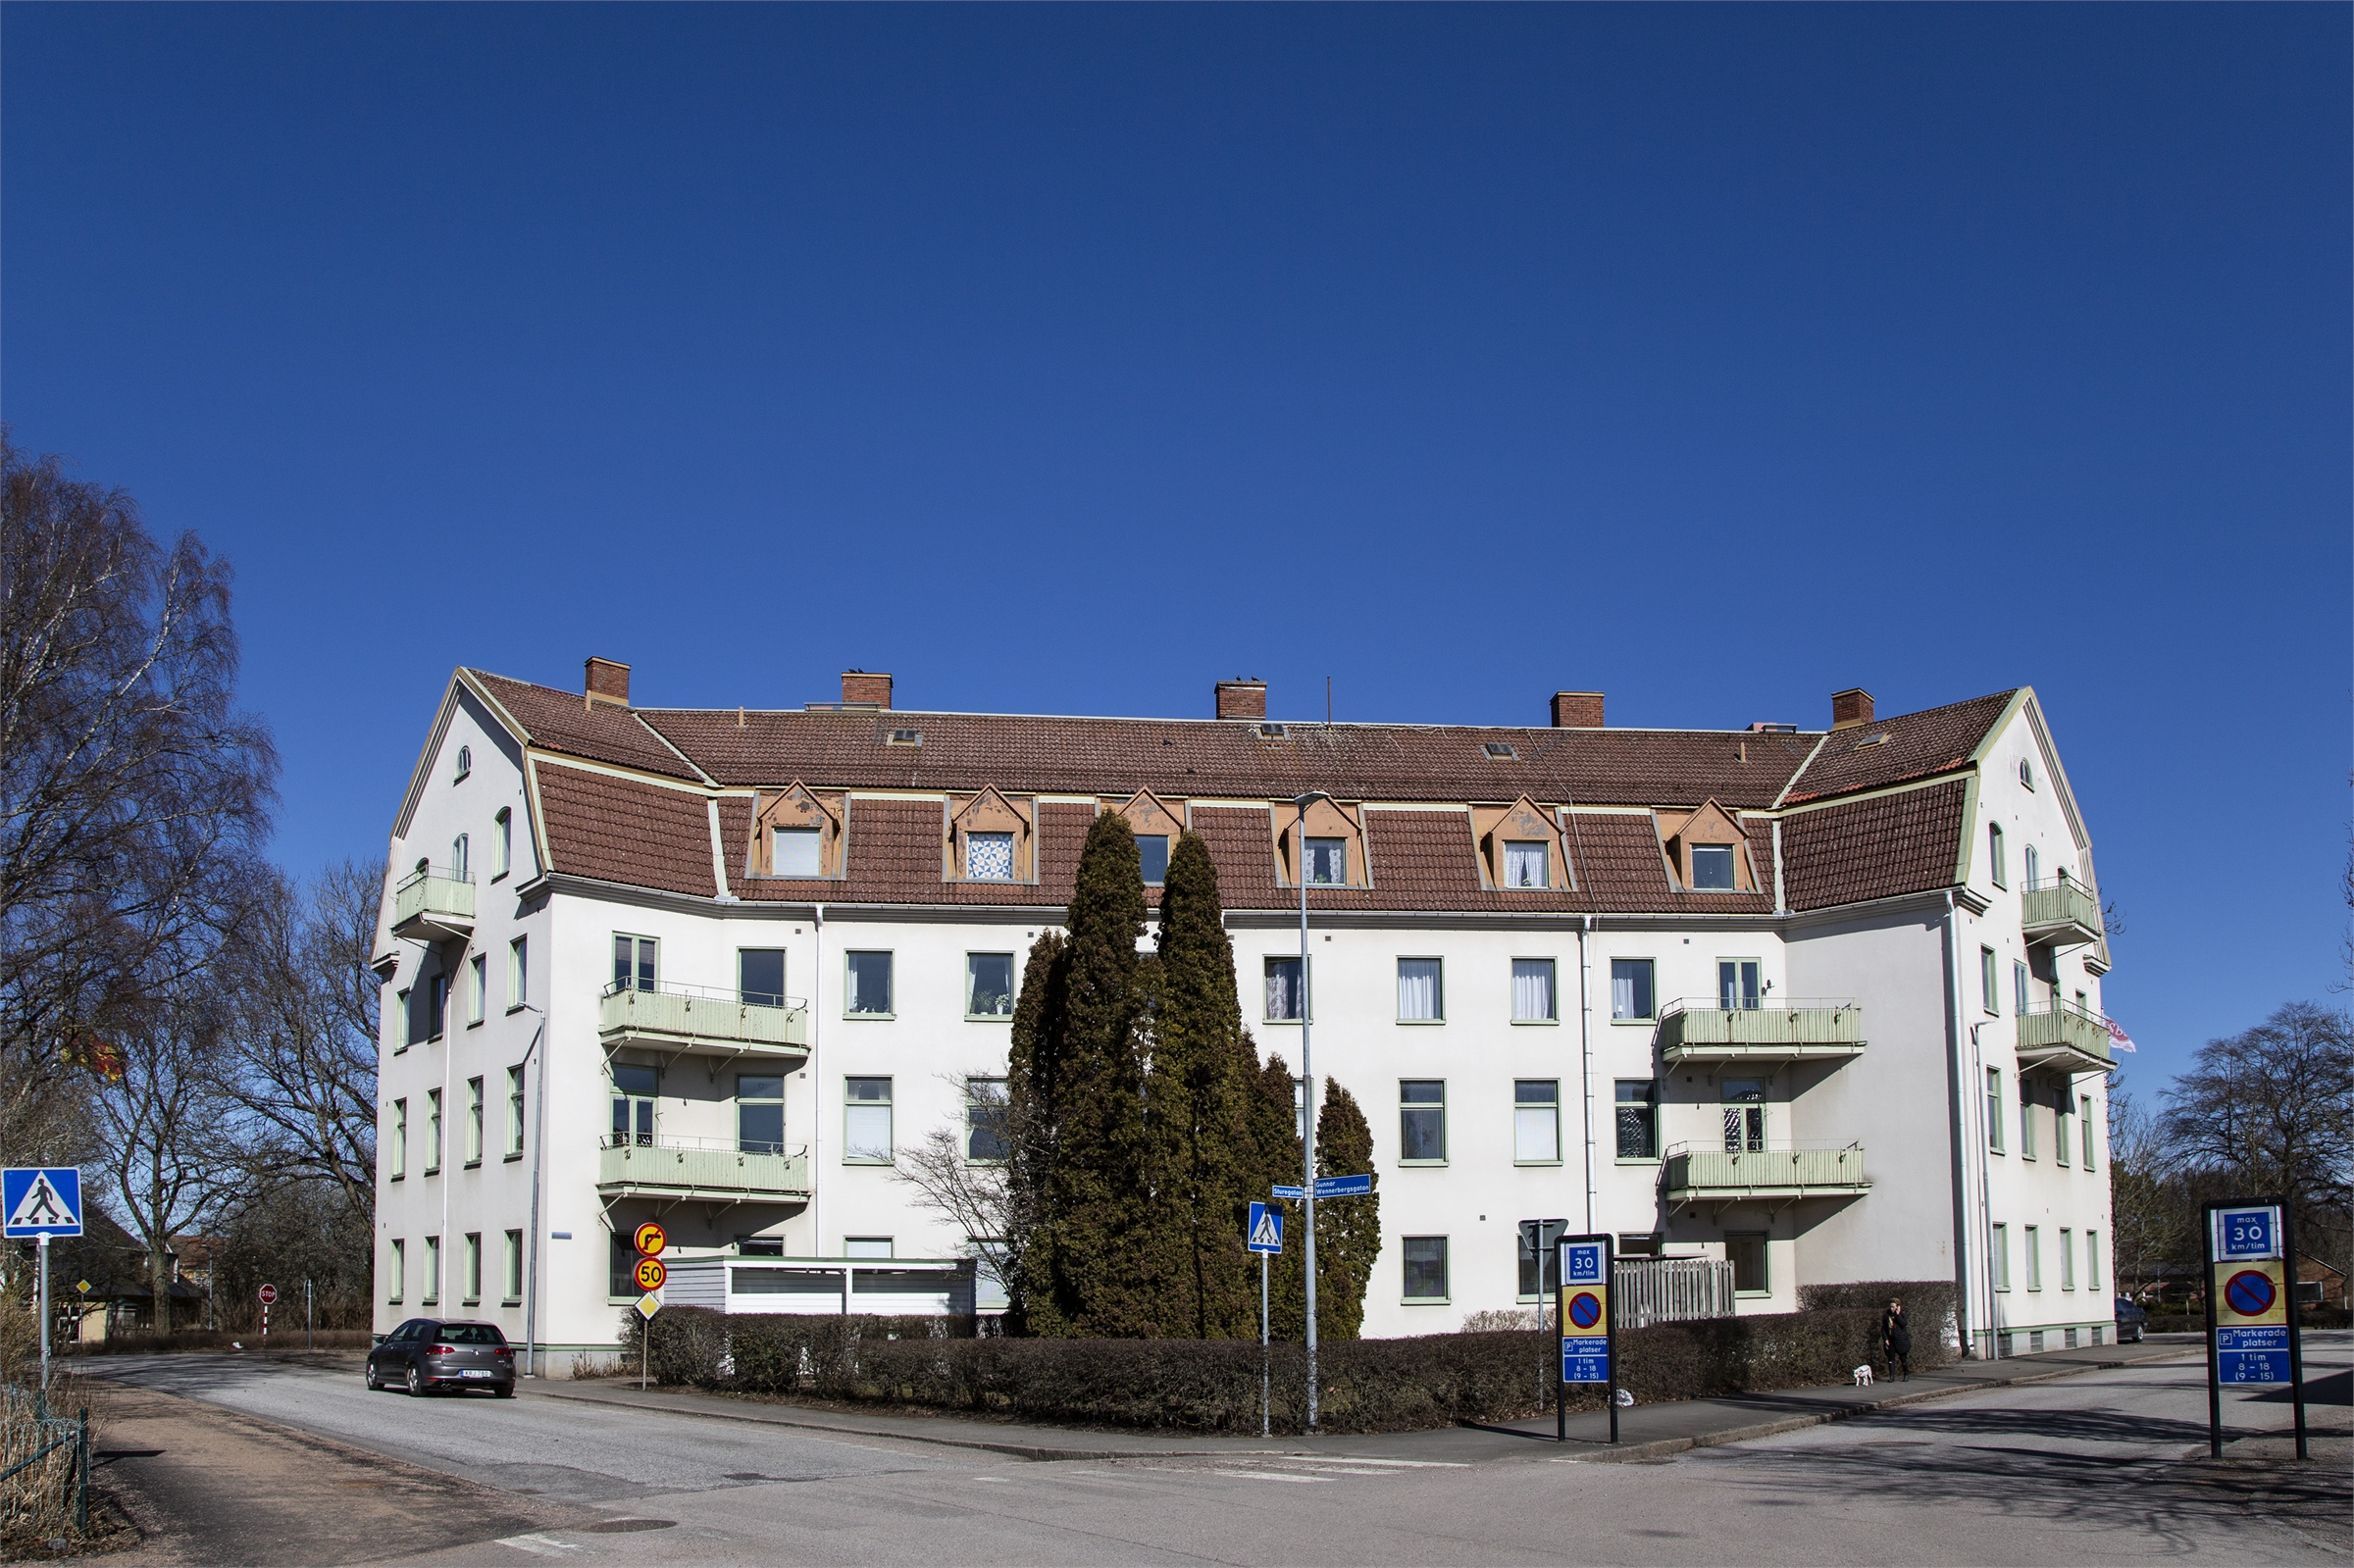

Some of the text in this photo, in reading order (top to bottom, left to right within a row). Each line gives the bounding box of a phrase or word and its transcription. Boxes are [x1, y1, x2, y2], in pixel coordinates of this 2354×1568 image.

[1274, 1188, 1303, 1196] Sturegatan
[1316, 1185, 1369, 1194] Wennerbergsgatan
[2233, 1226, 2263, 1240] 30
[1574, 1257, 1594, 1269] 30
[640, 1266, 662, 1283] 50
[2232, 1329, 2286, 1338] Markerade
[2242, 1339, 2277, 1347] platser
[2235, 1372, 2245, 1381] (9
